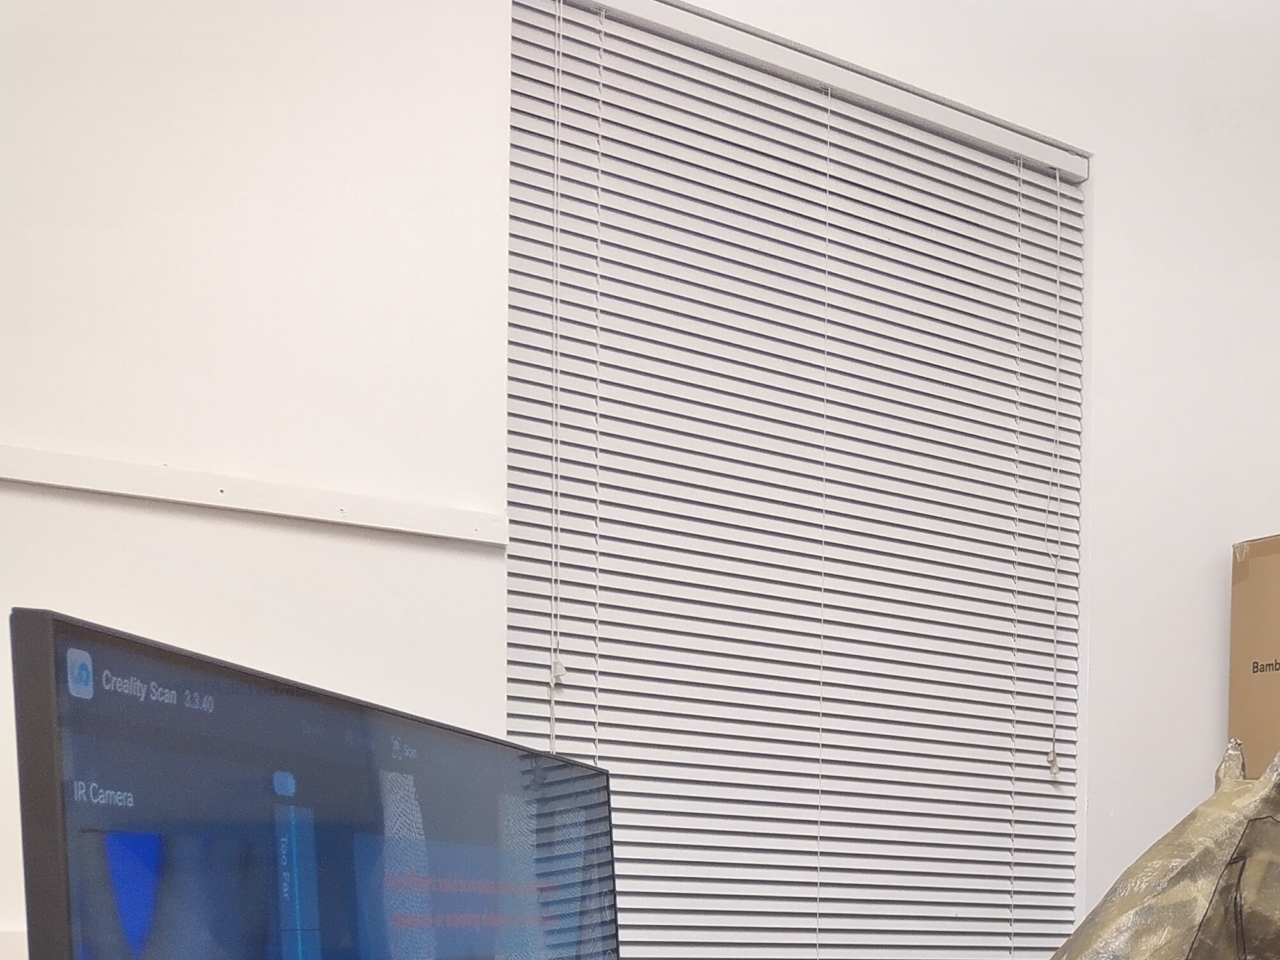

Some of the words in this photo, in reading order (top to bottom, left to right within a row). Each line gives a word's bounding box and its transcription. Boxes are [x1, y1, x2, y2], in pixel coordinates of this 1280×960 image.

[101, 668, 148, 703] Creality
[149, 680, 178, 707] Scan
[73, 780, 88, 803] IR
[89, 782, 134, 808] Camera
[279, 833, 290, 868] Too
